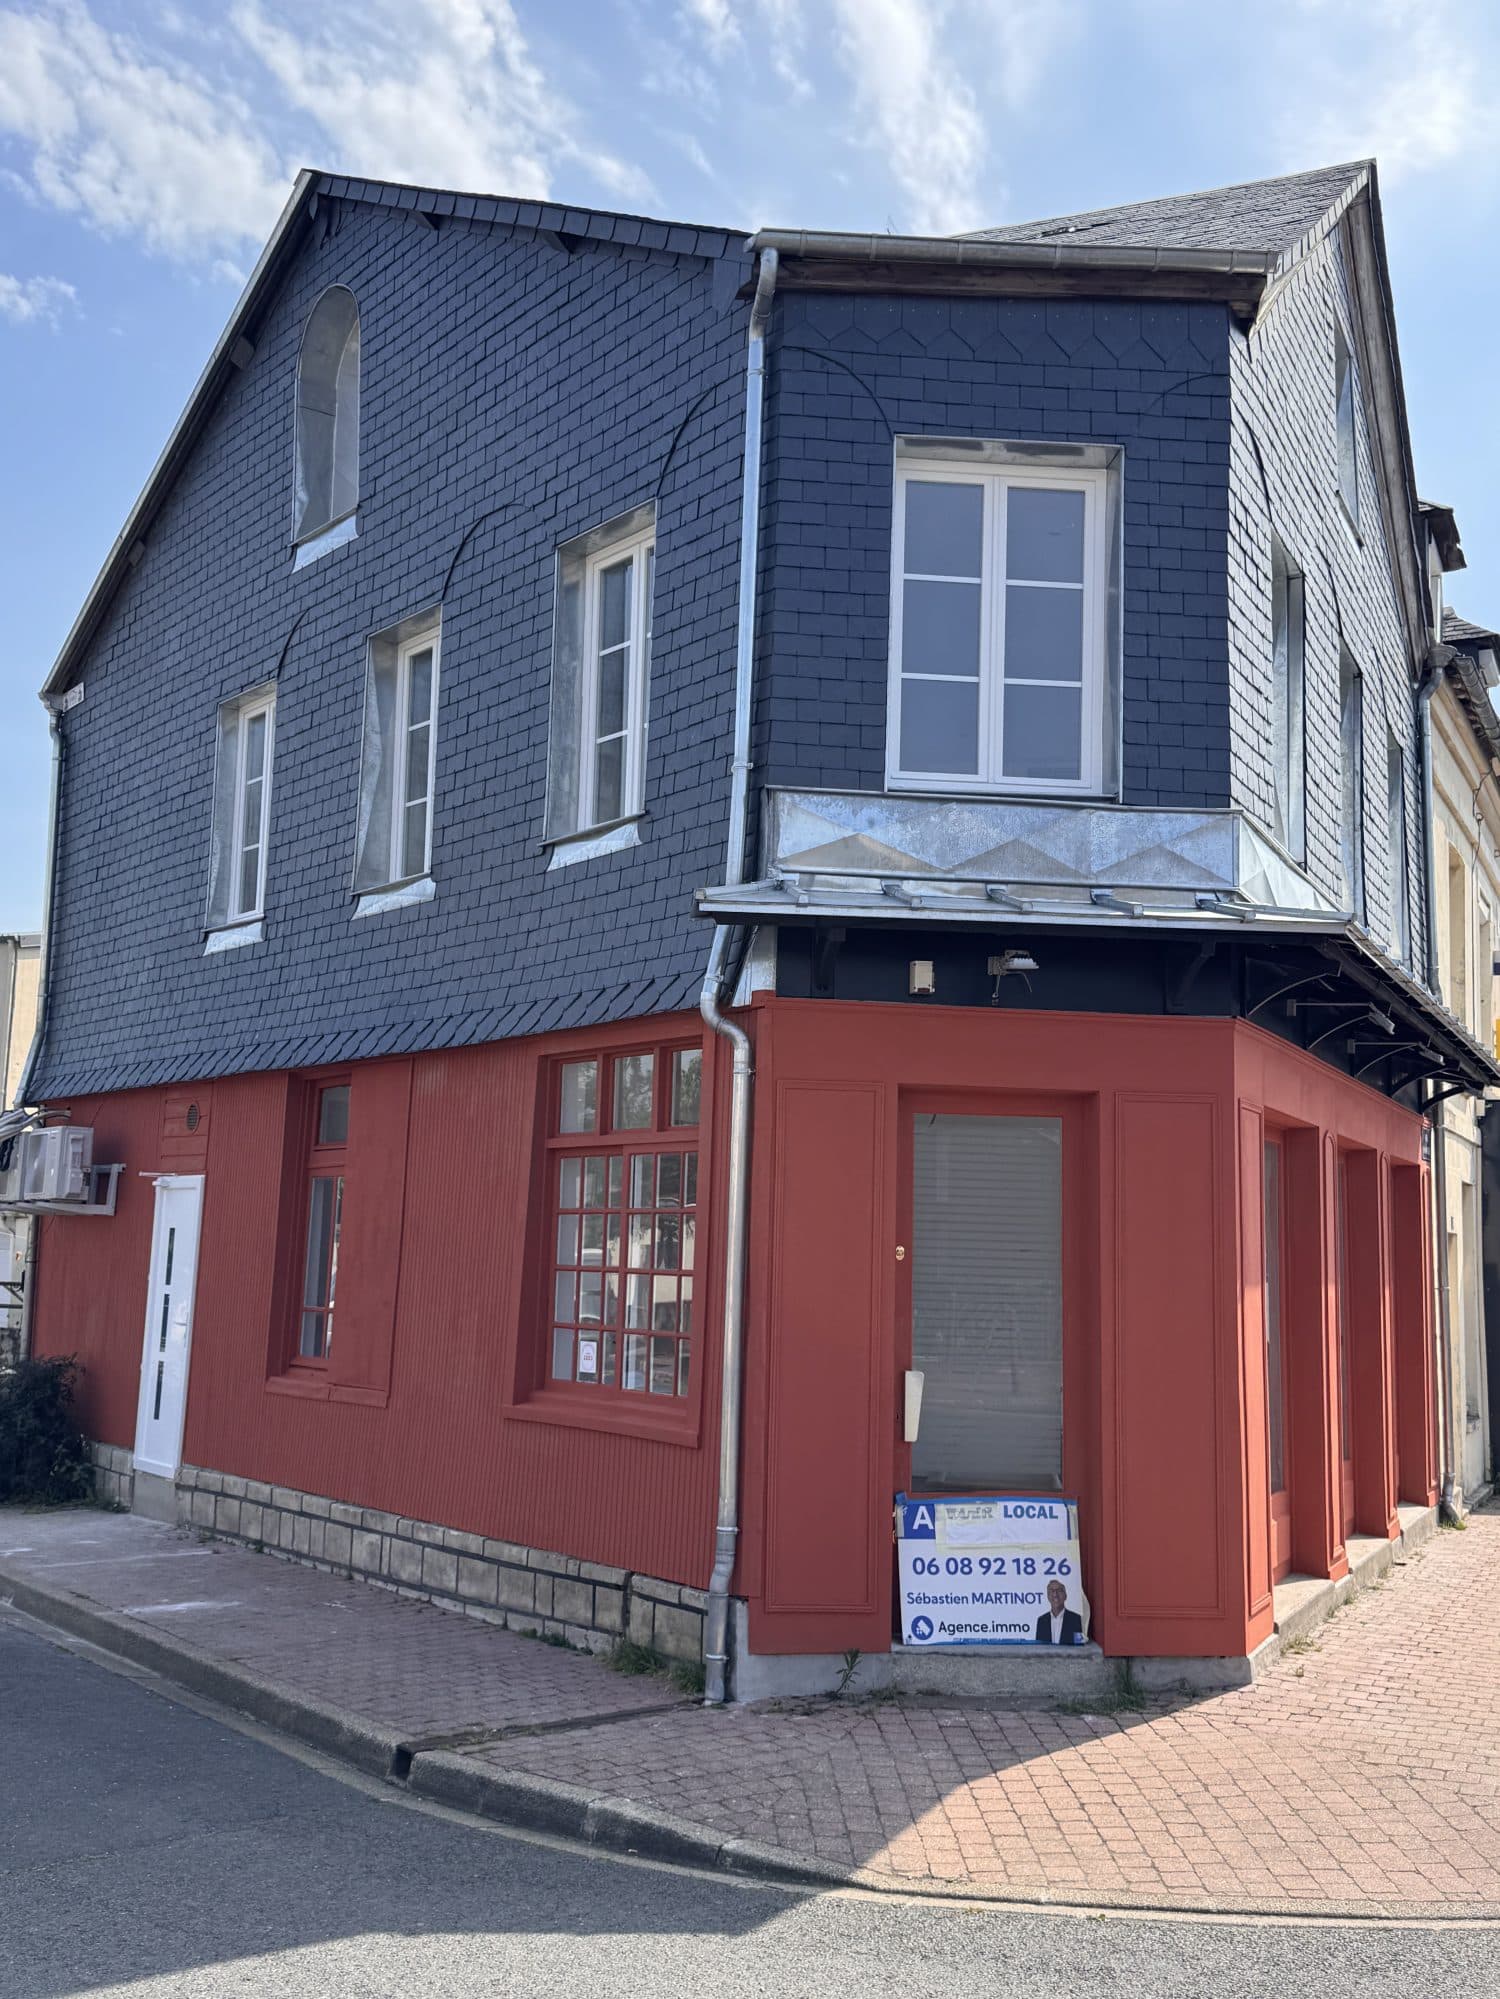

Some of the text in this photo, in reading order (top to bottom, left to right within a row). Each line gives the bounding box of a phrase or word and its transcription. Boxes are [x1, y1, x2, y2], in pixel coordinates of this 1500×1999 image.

[1003, 1505, 1059, 1520] LOCAL
[912, 1557, 1072, 1576] 06 08 92 18 26
[907, 1591, 1044, 1605] Sébastien MARTINOT
[938, 1620, 1031, 1635] Agence.immo
